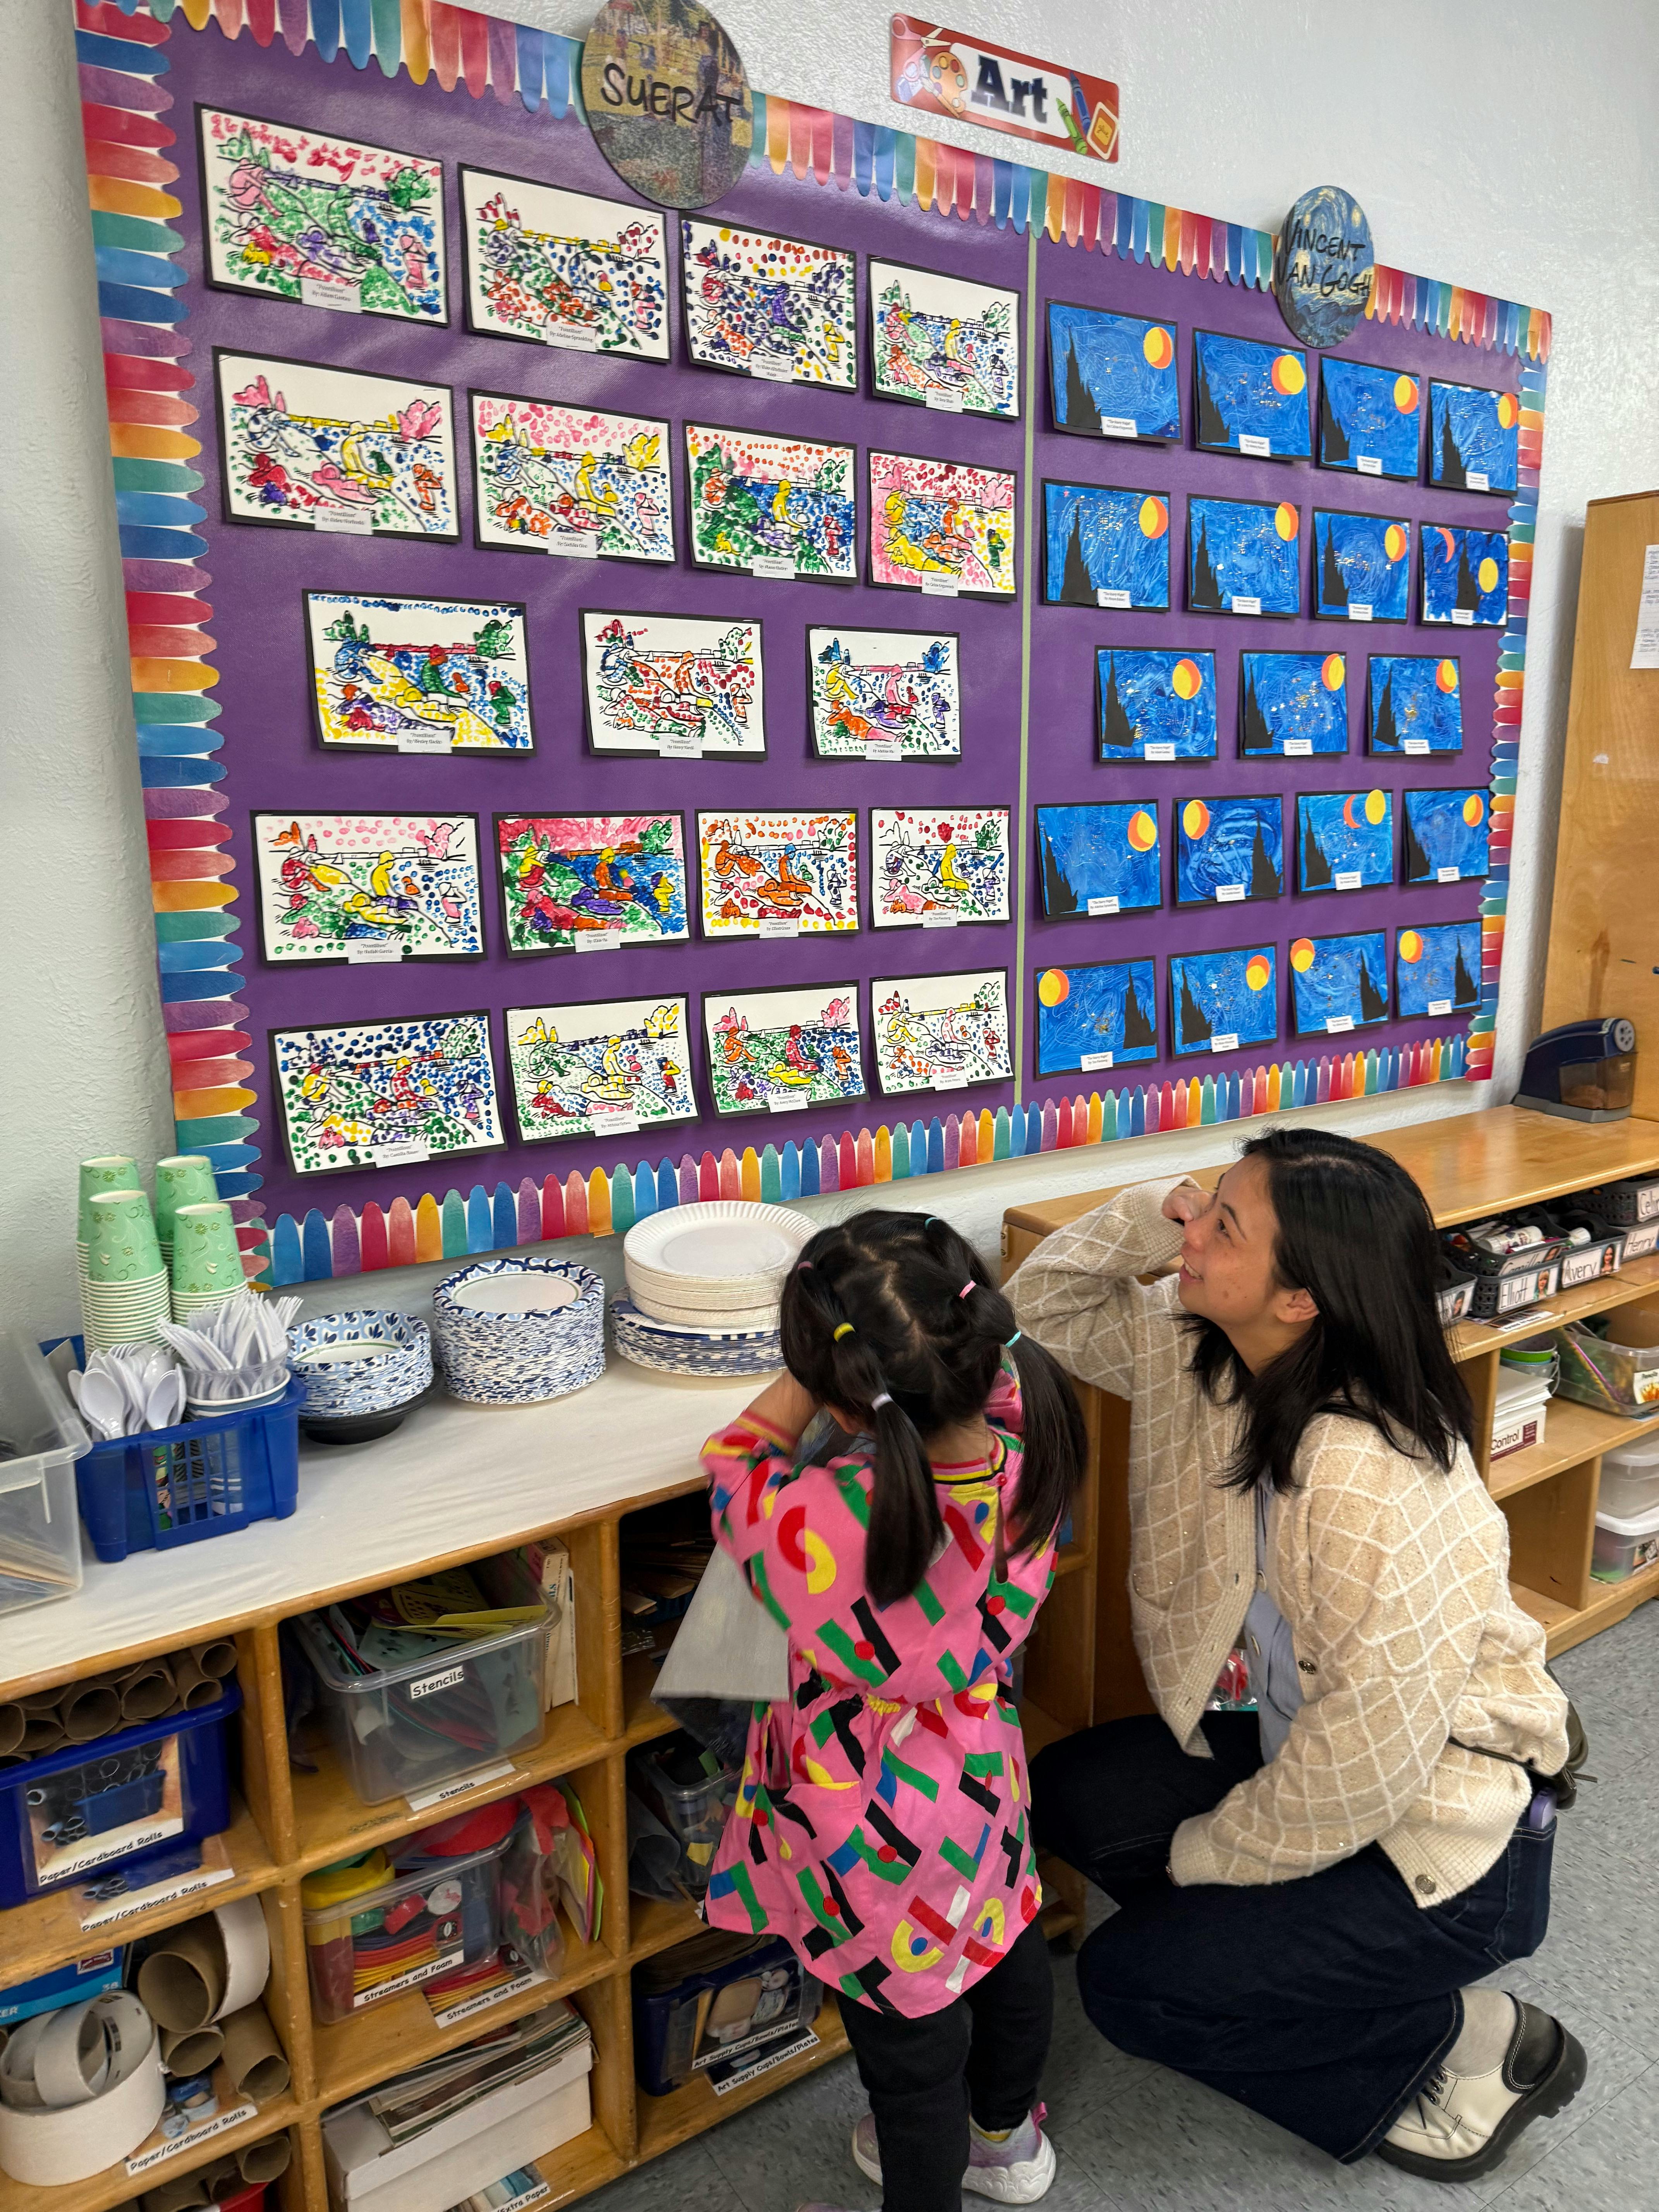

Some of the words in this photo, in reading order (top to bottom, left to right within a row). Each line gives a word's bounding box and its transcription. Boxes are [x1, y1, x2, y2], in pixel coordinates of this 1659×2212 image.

[601, 63, 741, 127] SUERAT
[971, 54, 1048, 123] Art
[1285, 219, 1366, 261] VINCENT
[1278, 257, 1315, 288] VAN
[1321, 265, 1372, 297] GOGH
[1564, 1260, 1597, 1281] Avery
[1491, 1429, 1519, 1450] Control
[413, 1671, 464, 1696] Stencils
[439, 1782, 475, 1799] Stencils
[40, 1842, 133, 1883] Paper/Cardboard
[137, 1831, 163, 1848] Rolls
[82, 1892, 177, 1932] Paper/Cardboard
[181, 1881, 208, 1895] Rolls
[364, 1979, 409, 2001] Streamers
[413, 1969, 428, 1982] and
[431, 1959, 453, 1974] Foam
[447, 1996, 490, 2020] Streamers
[494, 1986, 507, 1998] and
[511, 1977, 532, 1990] Foam
[694, 2058, 706, 2068] Art
[709, 2048, 733, 2061] Supply
[718, 2083, 730, 2092] Art
[732, 2071, 755, 2084] Supply
[757, 2037, 818, 2071] Cups/Bowls/Plates
[130, 2122, 219, 2171] Paper/Cardboard
[222, 2110, 247, 2125] Rolls
[526, 2186, 548, 2202] Paper
